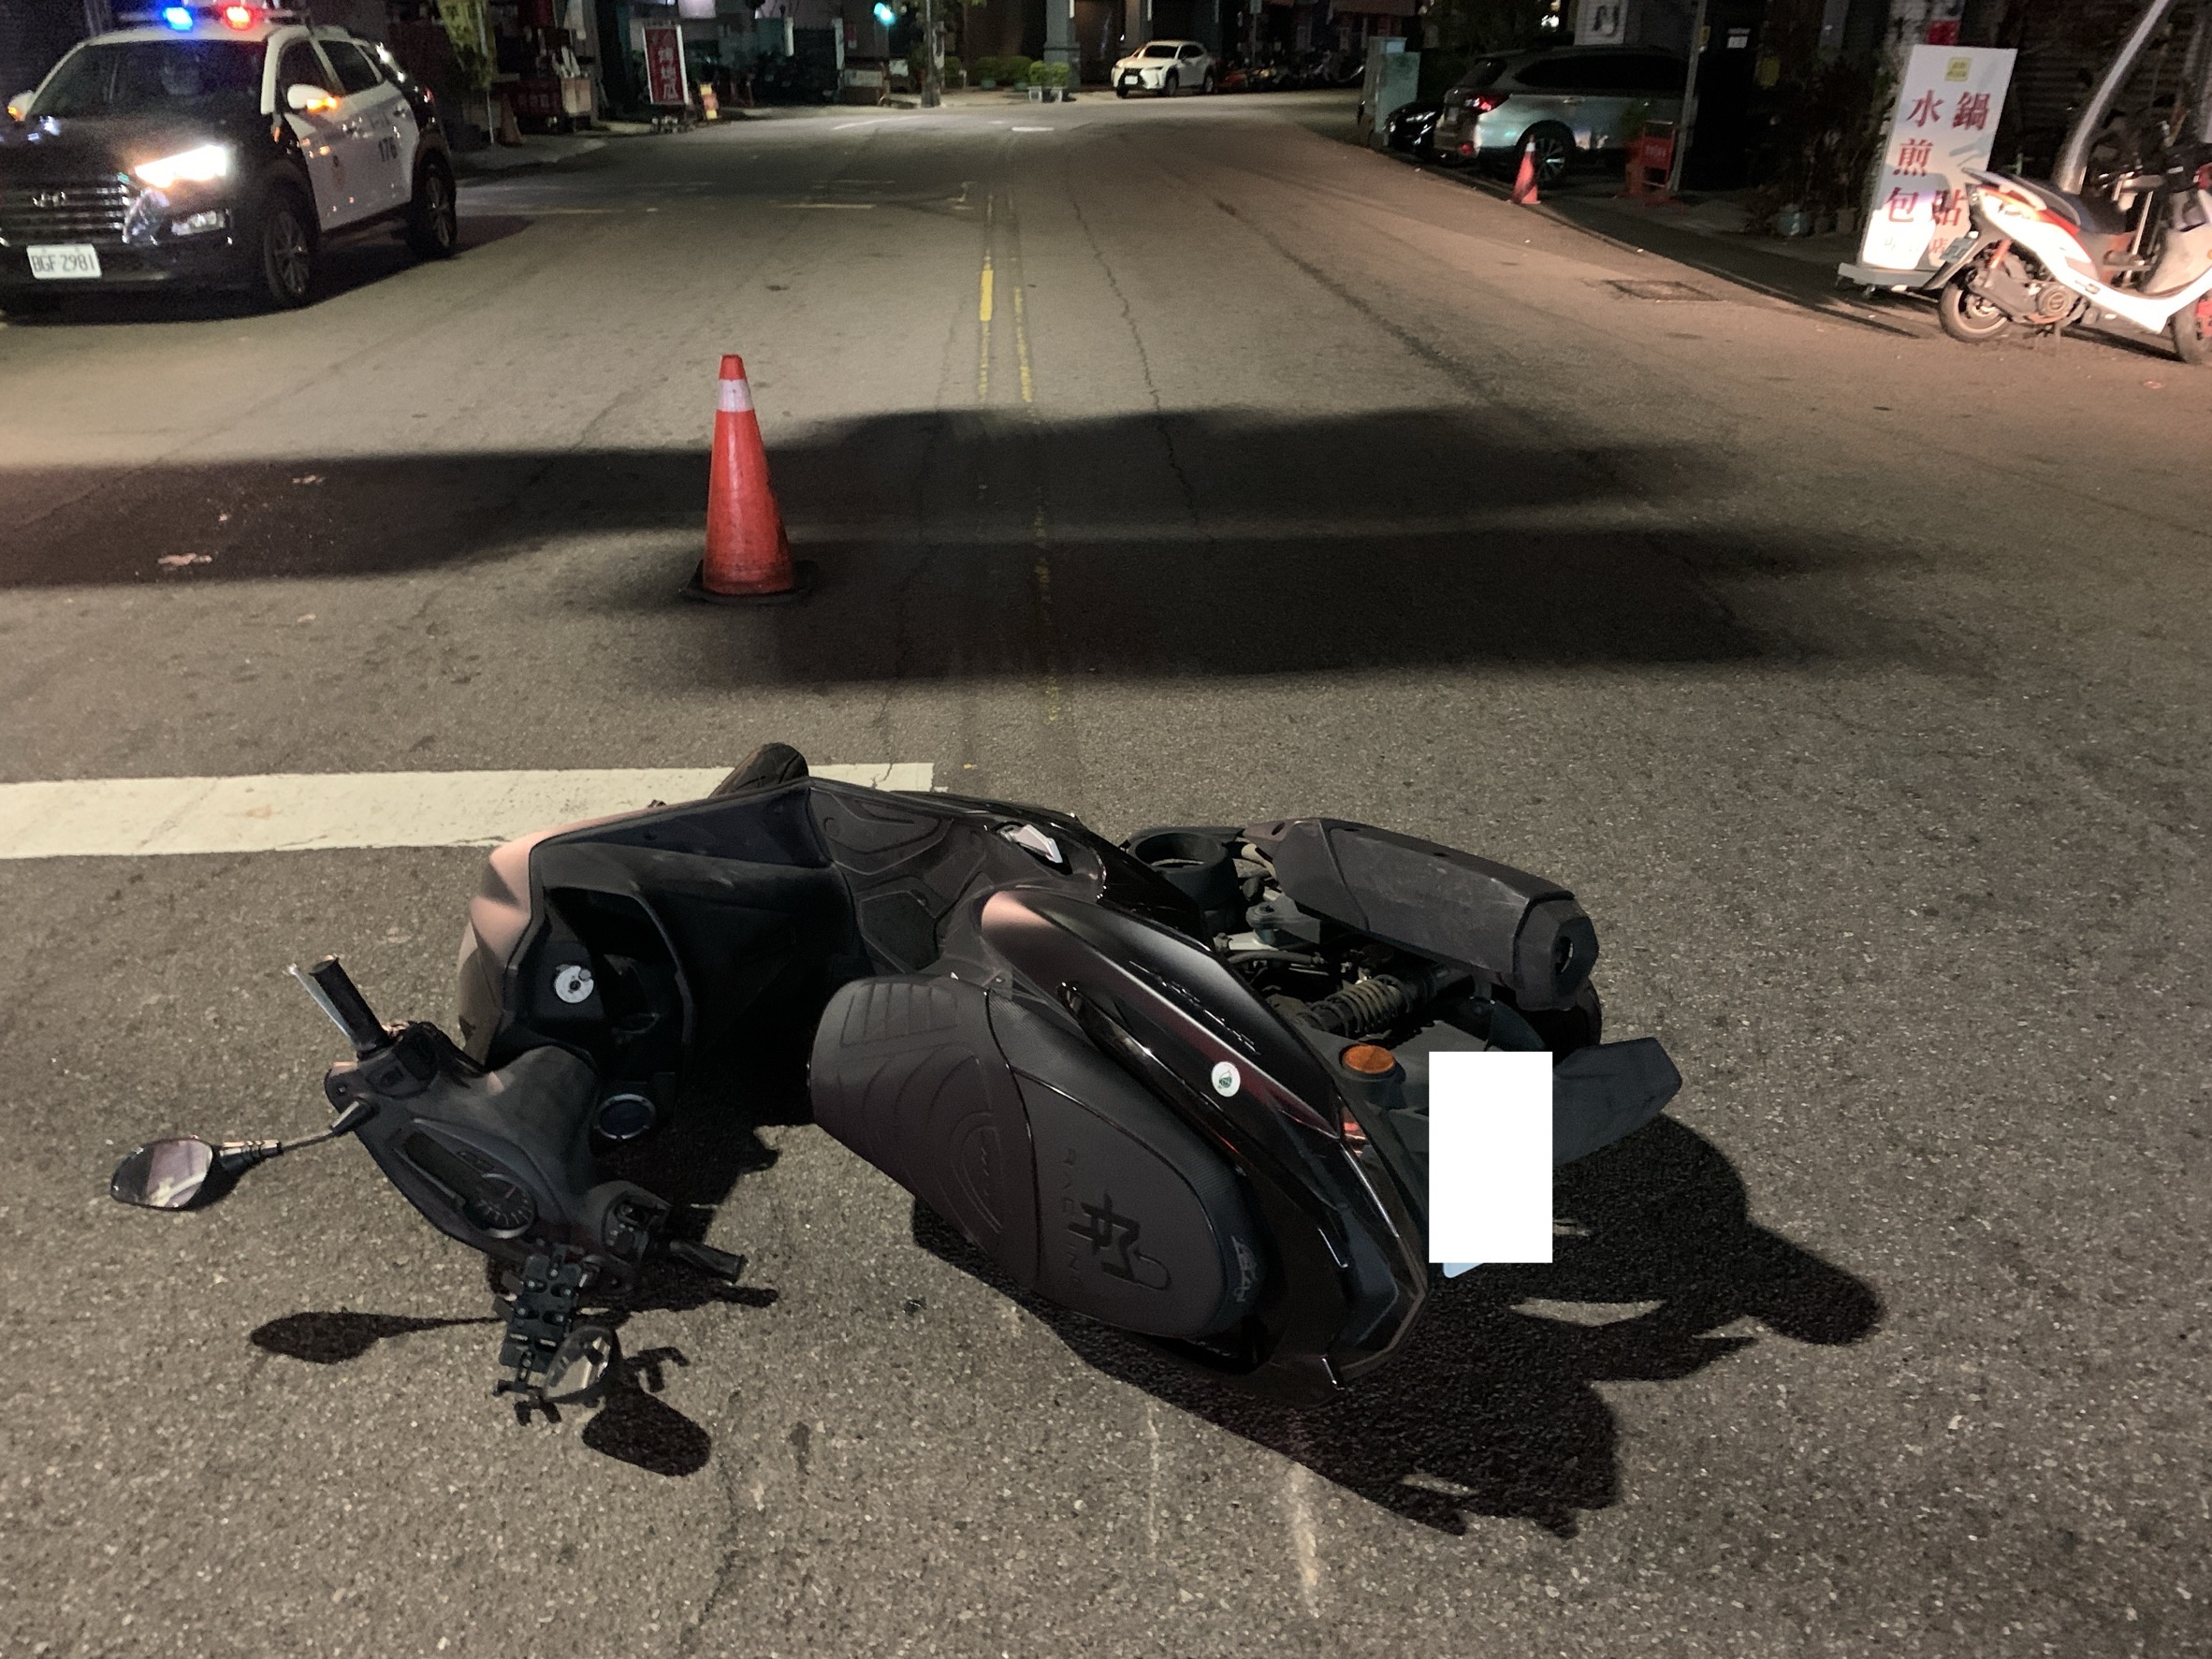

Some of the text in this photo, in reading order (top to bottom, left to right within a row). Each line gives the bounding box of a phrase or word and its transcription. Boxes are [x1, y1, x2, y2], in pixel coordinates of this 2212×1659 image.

[1887, 90, 1944, 223] 水煎包
[1929, 93, 1990, 226] 鍋貼
